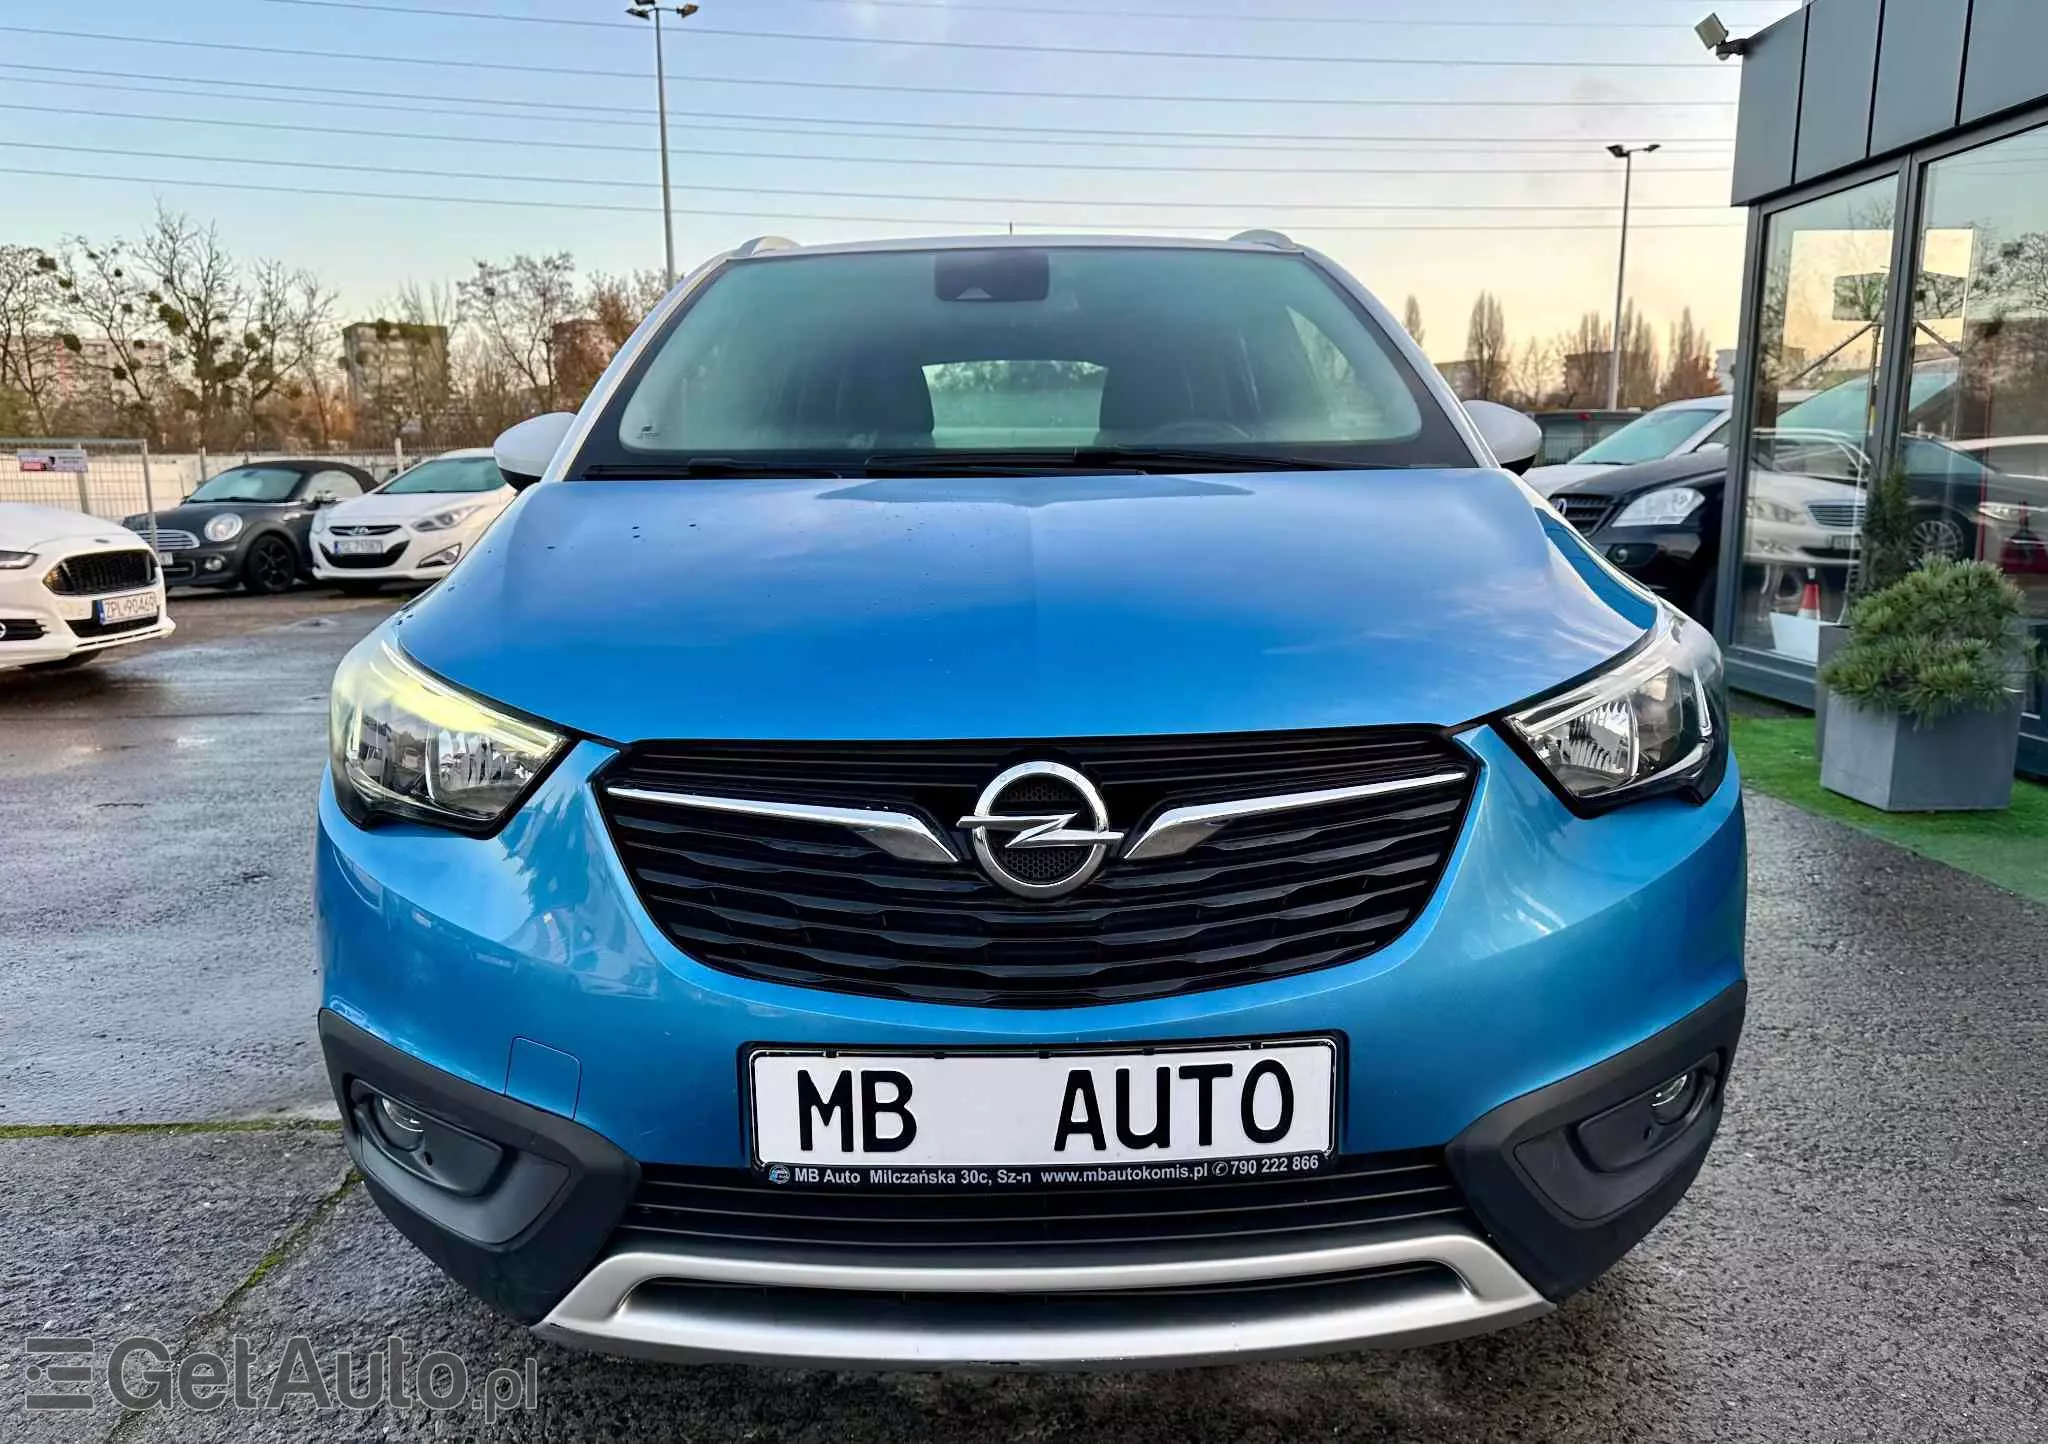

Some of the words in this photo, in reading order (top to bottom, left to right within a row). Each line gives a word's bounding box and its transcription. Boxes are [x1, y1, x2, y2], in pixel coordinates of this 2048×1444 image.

[796, 1068, 918, 1153] MB
[1053, 1059, 1295, 1152] AUTO
[794, 1168, 819, 1182] MB
[823, 1168, 861, 1184] Auto
[869, 1169, 956, 1184] Milczańska
[960, 1170, 993, 1186] 30c,
[996, 1170, 1032, 1184] Sz-n
[1040, 1163, 1208, 1183] www.mbautokomis.pl
[1230, 1160, 1257, 1175] 790
[1261, 1157, 1288, 1173] 222
[1292, 1154, 1319, 1170] 866
